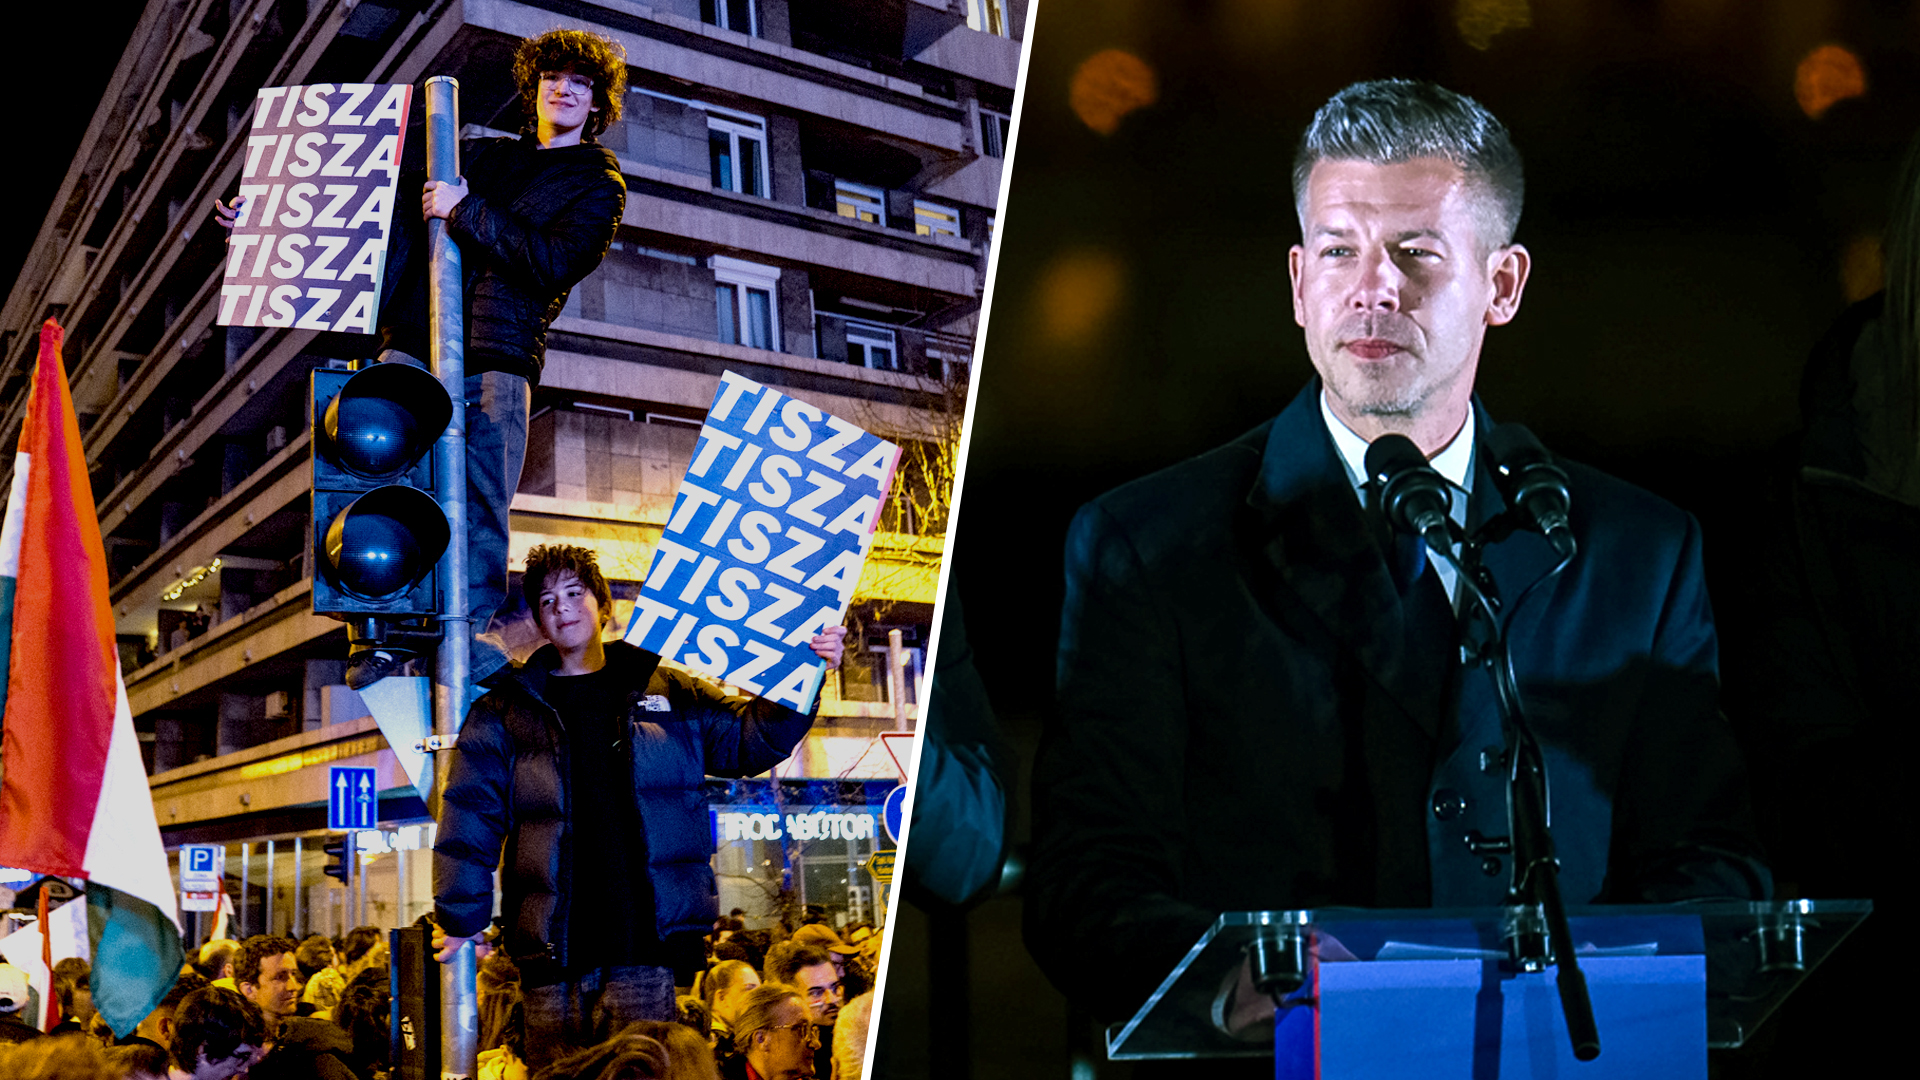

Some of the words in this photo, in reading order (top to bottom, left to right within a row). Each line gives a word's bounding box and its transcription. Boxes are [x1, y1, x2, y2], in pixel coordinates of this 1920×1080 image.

[251, 83, 406, 128] TISZA
[243, 132, 399, 178] TISZA
[234, 182, 393, 230] TISZA
[225, 233, 384, 283] TISZA
[217, 284, 375, 334] TISZA
[709, 370, 898, 491] TISZA
[688, 424, 880, 547] TISZA
[667, 480, 863, 601] TISZA
[645, 537, 841, 647] TISZA
[623, 595, 820, 712] TISZA
[194, 850, 209, 870] P
